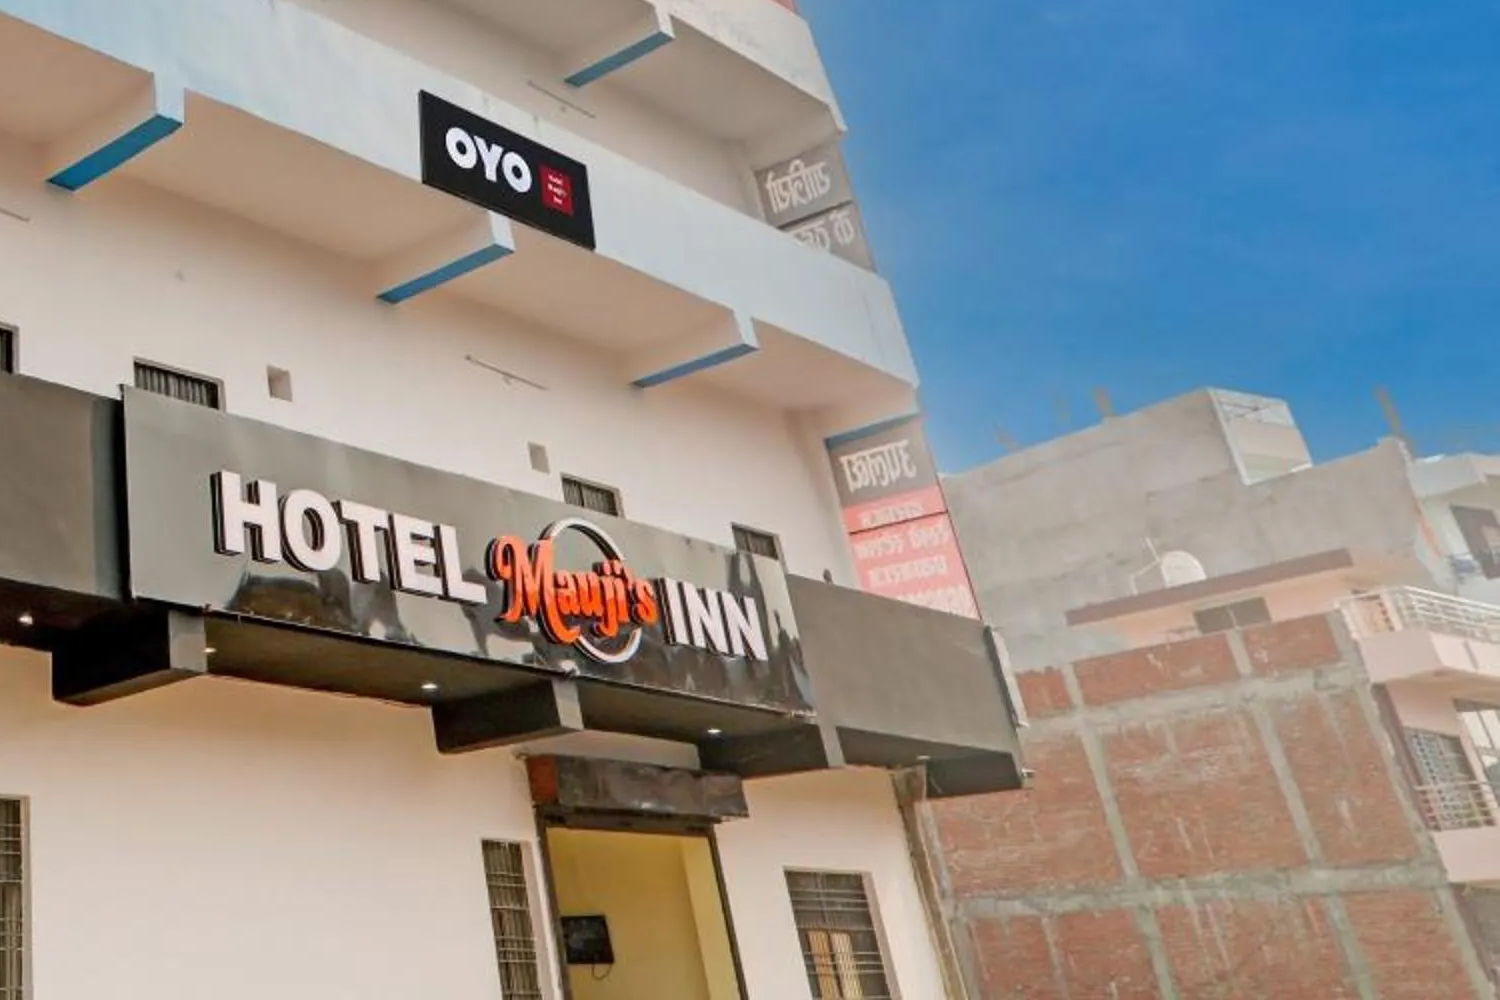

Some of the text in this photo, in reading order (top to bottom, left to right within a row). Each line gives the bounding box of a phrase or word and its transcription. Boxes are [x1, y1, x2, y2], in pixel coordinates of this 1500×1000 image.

[445, 127, 532, 193] OYO
[212, 469, 769, 661] HOTEL Mauji's INN
